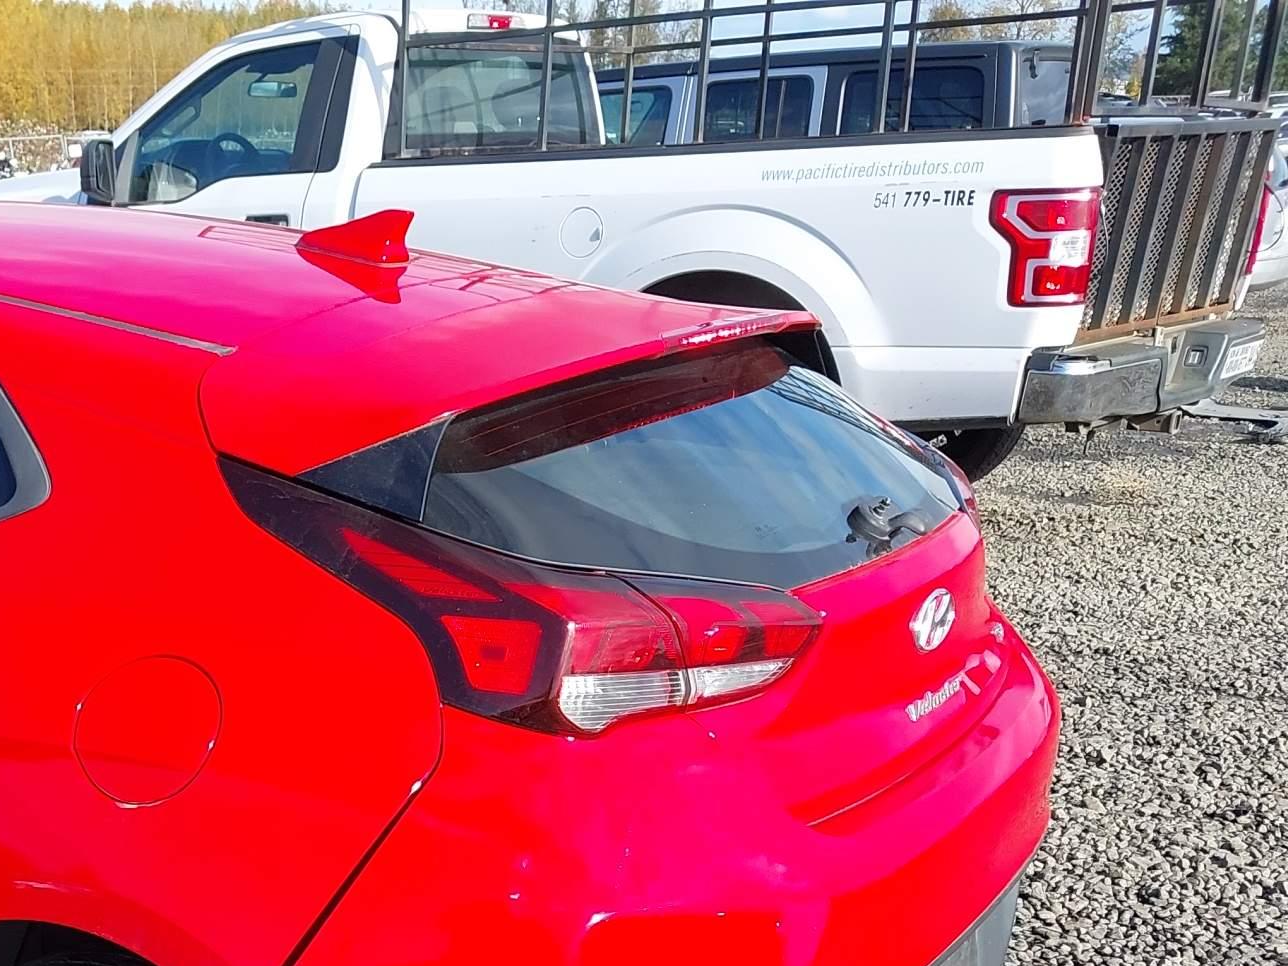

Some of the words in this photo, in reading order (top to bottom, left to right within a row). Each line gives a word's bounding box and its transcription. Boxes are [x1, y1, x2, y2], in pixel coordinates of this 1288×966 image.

[761, 160, 985, 184] www.pacifictiredistributors.com
[873, 192, 898, 209] 541
[903, 190, 977, 208] 779-TIRE
